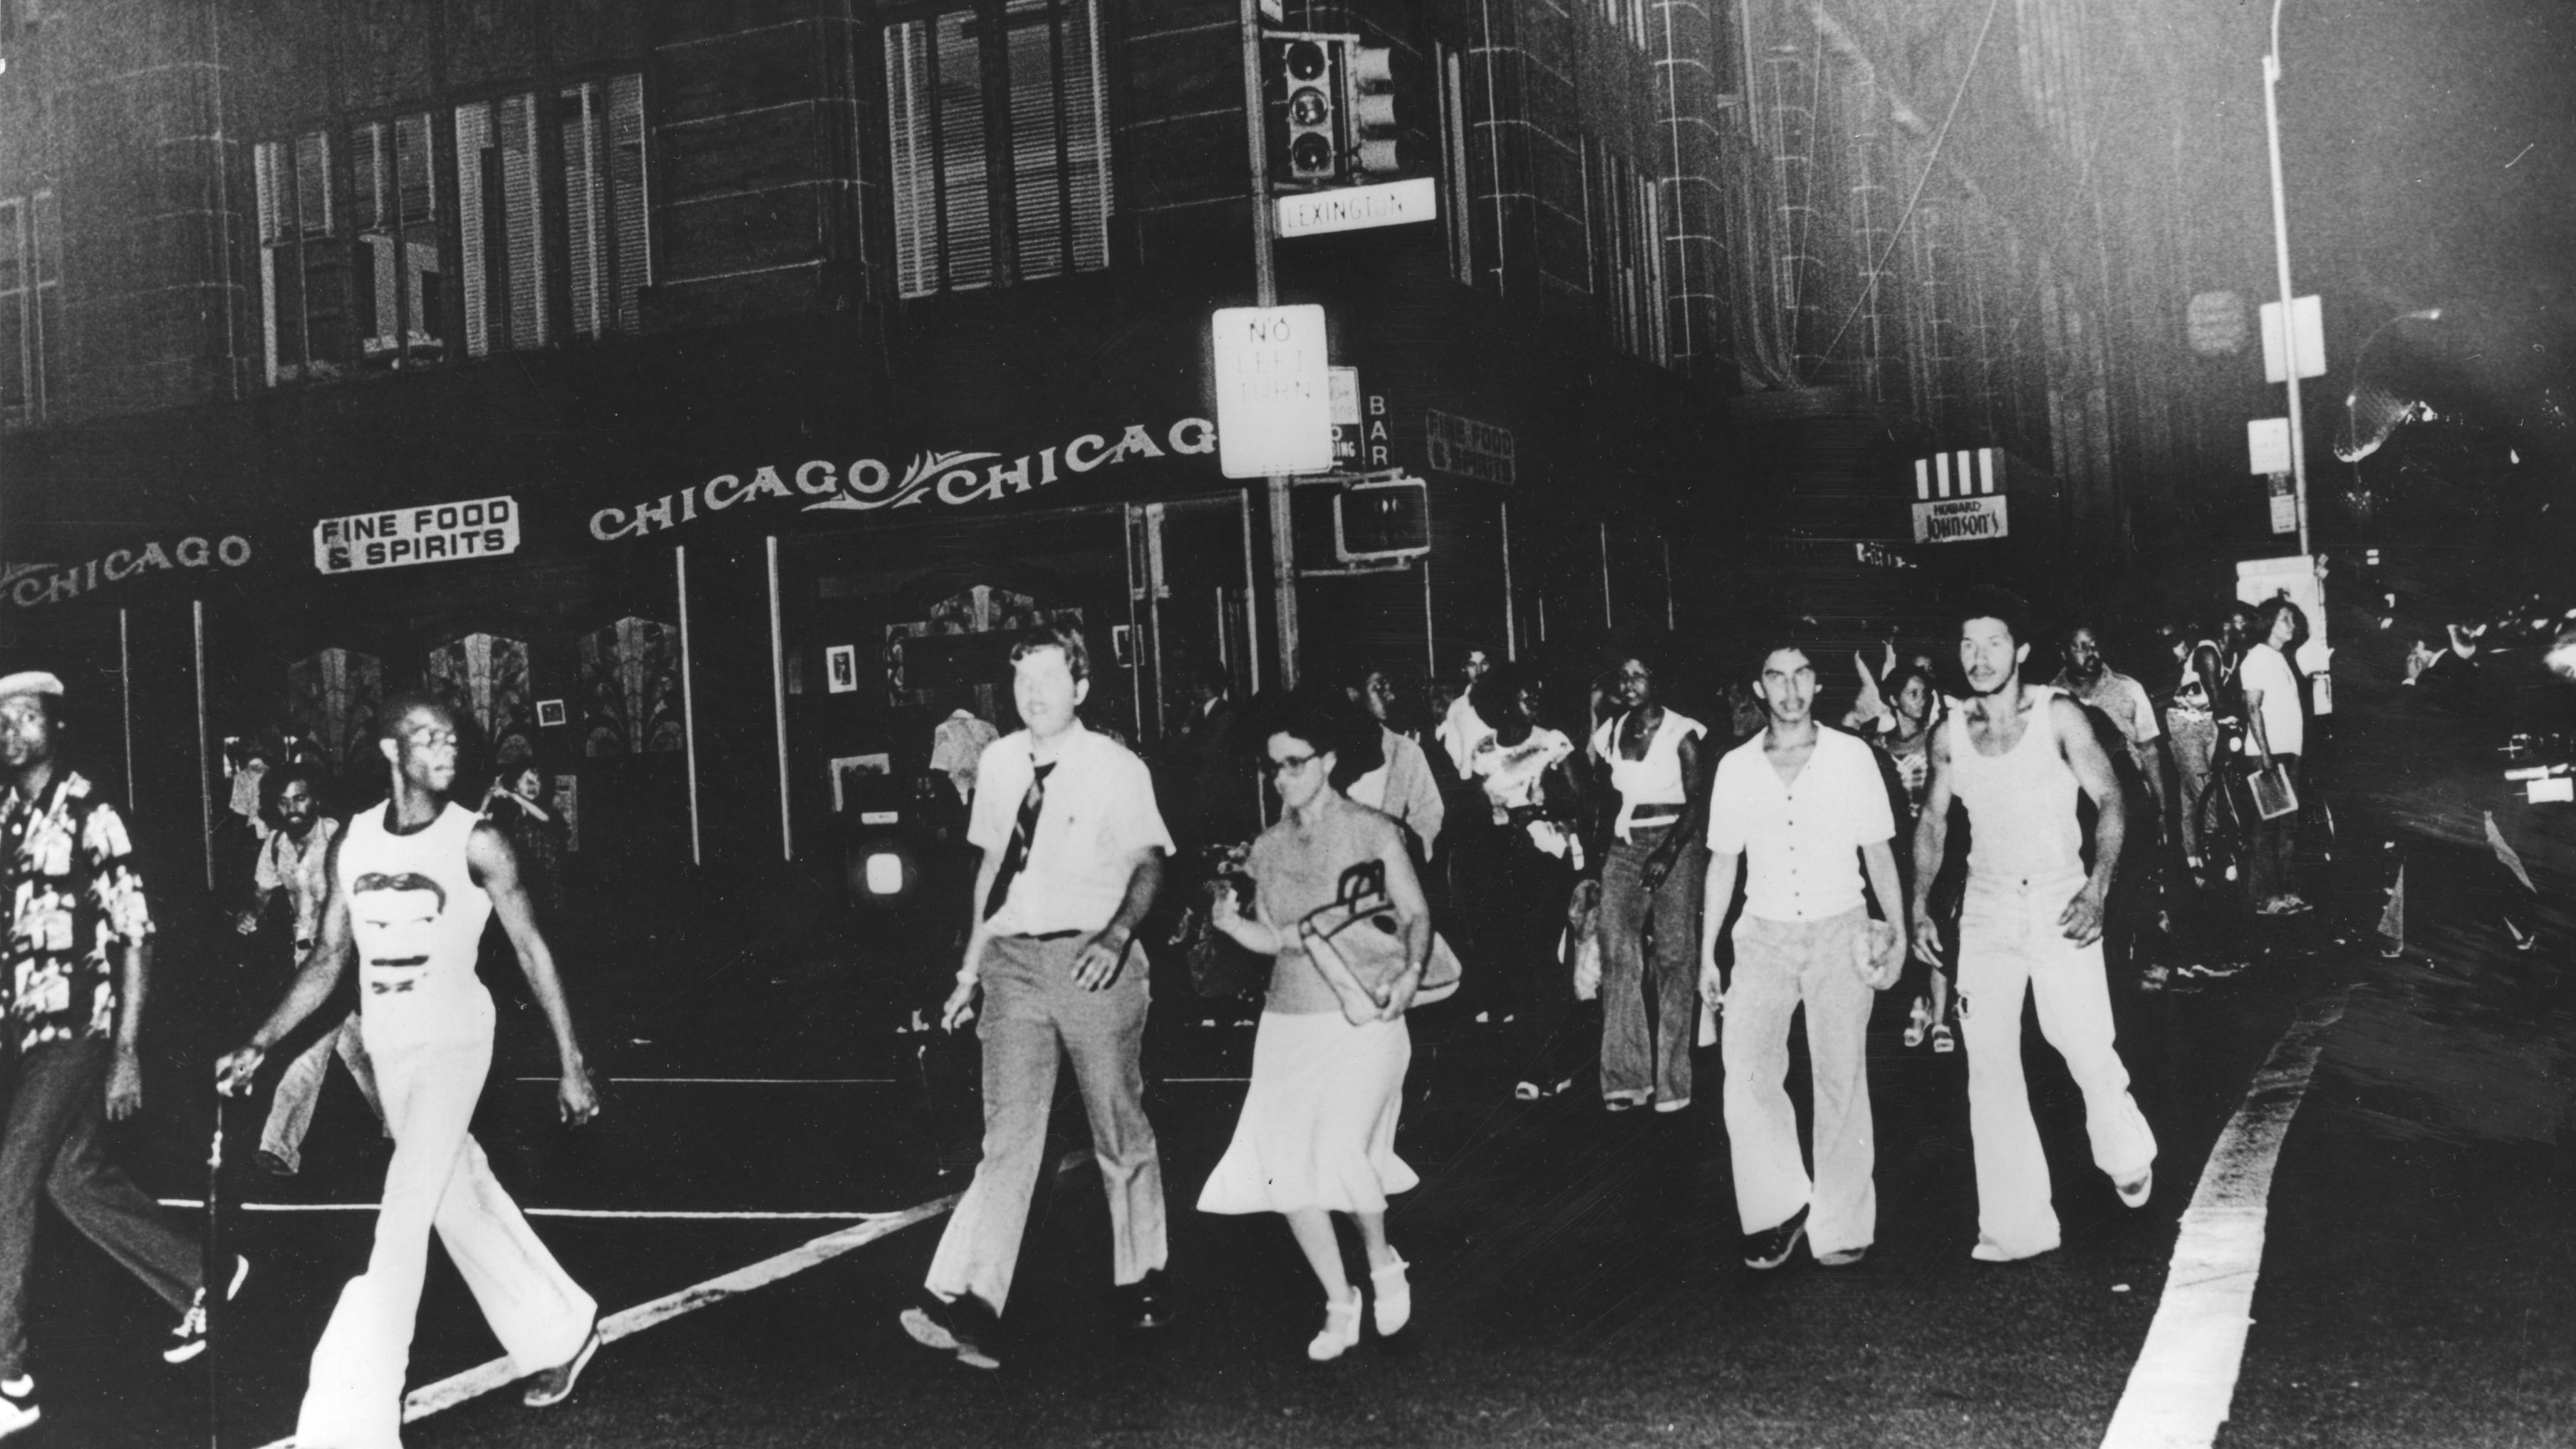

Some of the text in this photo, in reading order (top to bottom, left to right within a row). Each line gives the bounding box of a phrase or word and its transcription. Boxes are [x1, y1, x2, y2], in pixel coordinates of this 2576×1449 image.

[1287, 193, 1403, 229] LEXINGTON
[1249, 318, 1290, 343] NO
[1237, 349, 1304, 375] LEFT
[1237, 380, 1312, 404] TURN
[1369, 395, 1388, 465] BAR
[589, 417, 1217, 541] CHICAGO CHICAG
[322, 500, 509, 544] FINE FOOD
[1933, 500, 1982, 516] HOWARD
[328, 528, 504, 570] & SPIRITS
[13, 535, 251, 606] CHICAGO
